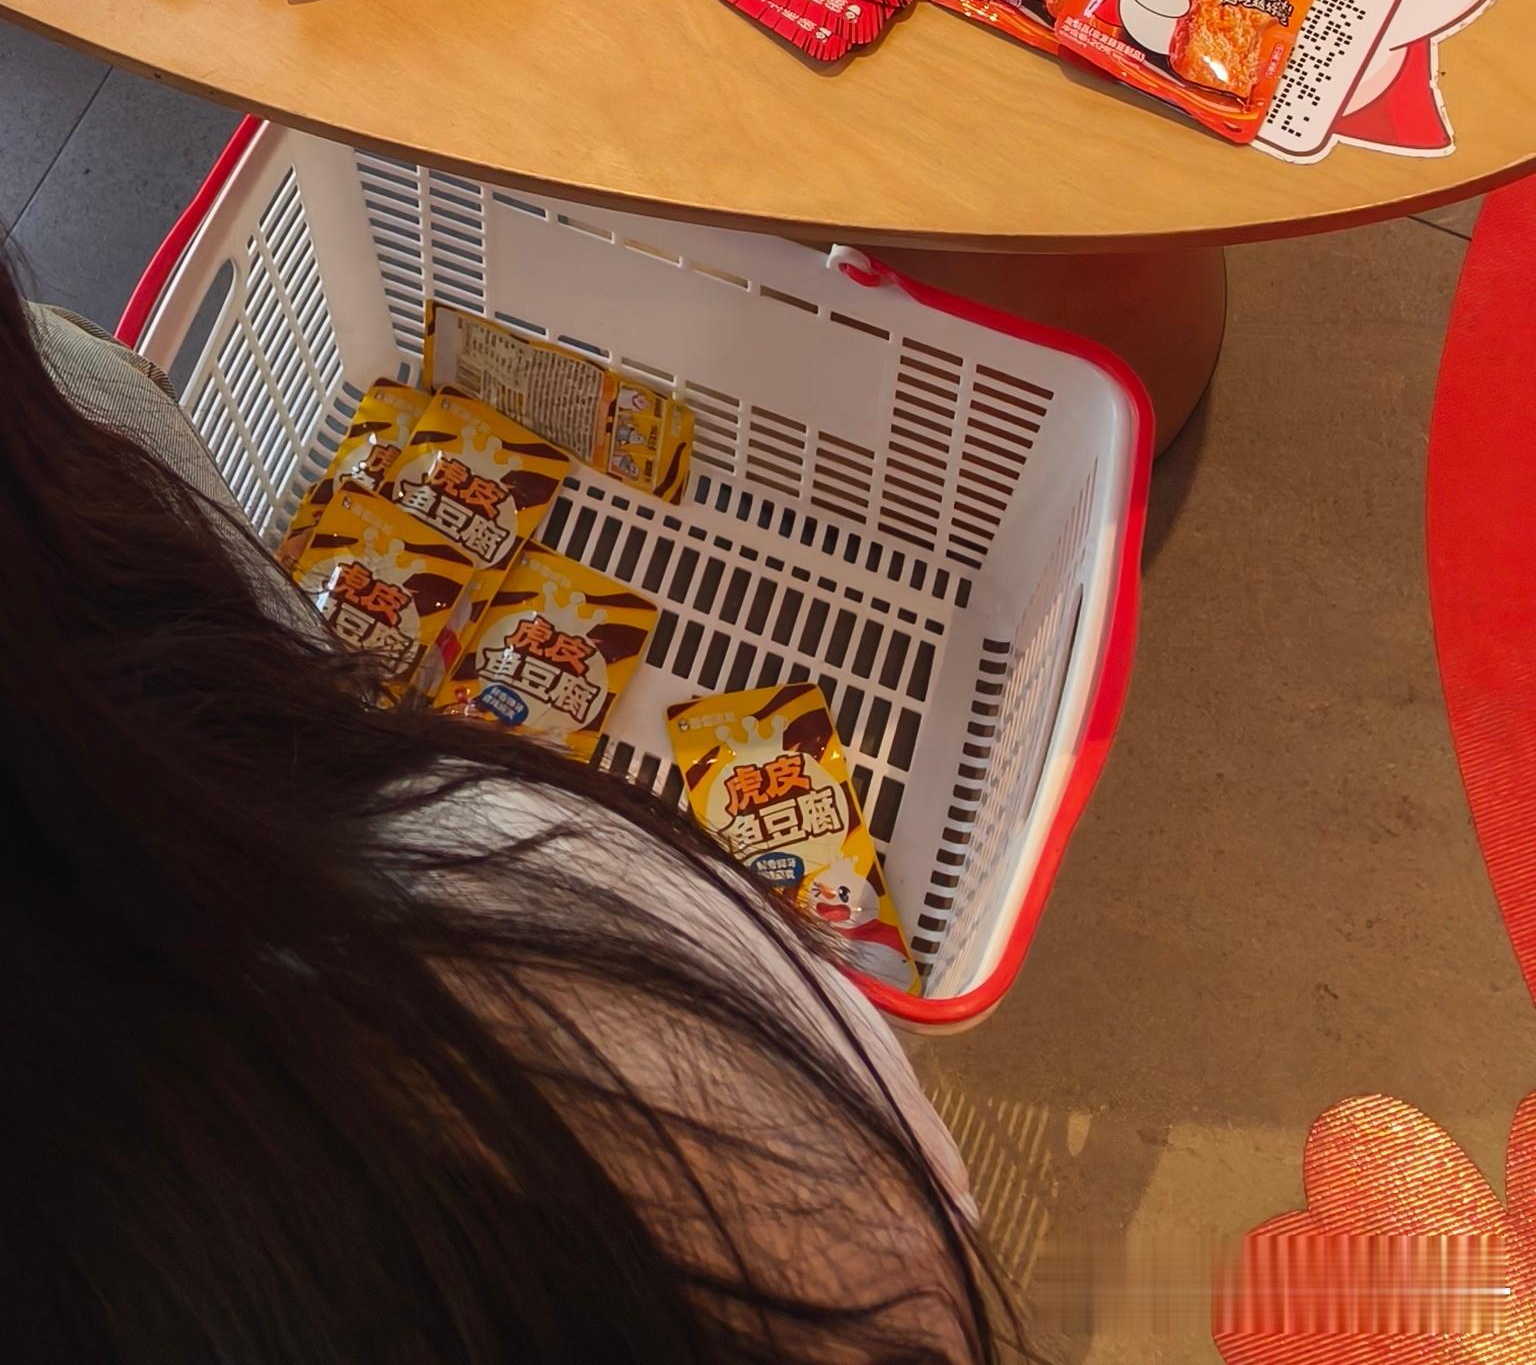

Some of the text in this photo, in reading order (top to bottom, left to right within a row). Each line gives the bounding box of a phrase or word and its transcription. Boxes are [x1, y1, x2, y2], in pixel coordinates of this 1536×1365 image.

[428, 457, 507, 518] 虎皮
[401, 482, 511, 563] 鱼豆腐
[338, 563, 411, 625] 虎皮
[508, 617, 597, 674] 虎皮
[476, 645, 602, 724] 鱼豆腐
[725, 754, 811, 815] 虎皮
[720, 787, 845, 859] 鱼豆腐
